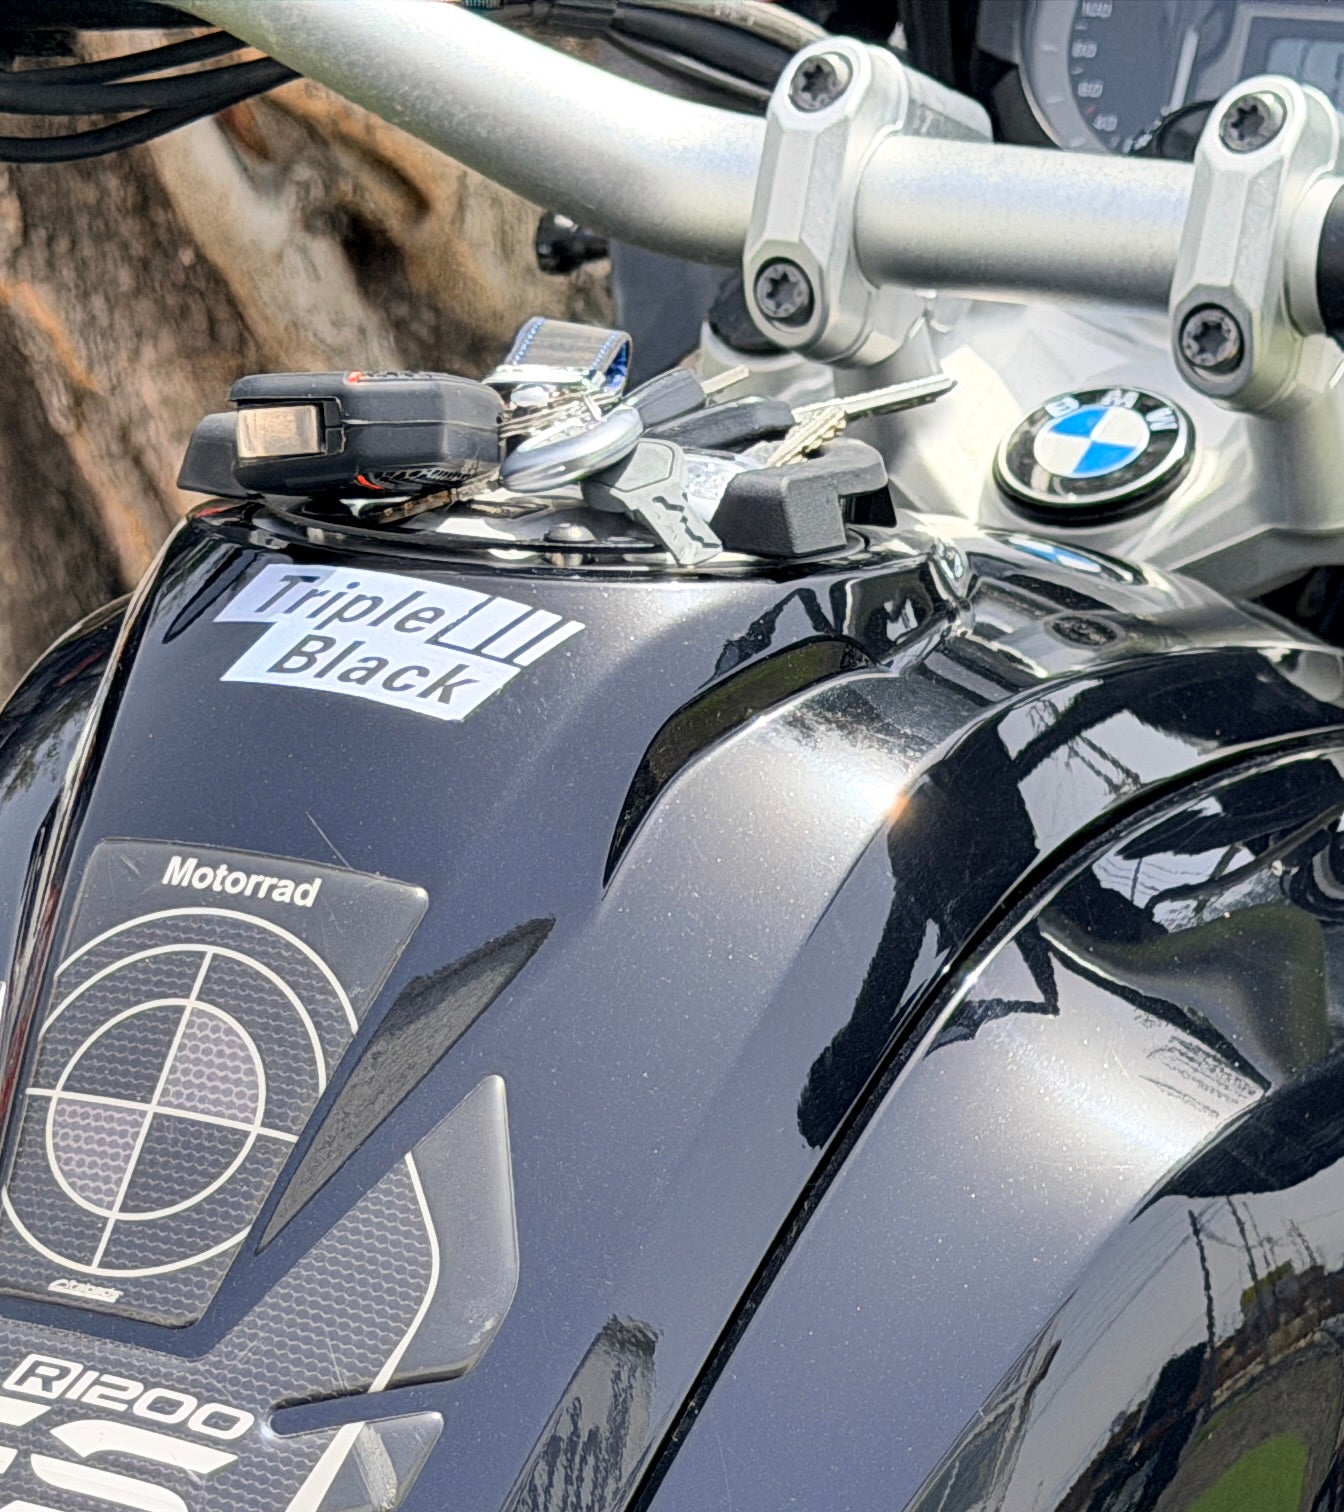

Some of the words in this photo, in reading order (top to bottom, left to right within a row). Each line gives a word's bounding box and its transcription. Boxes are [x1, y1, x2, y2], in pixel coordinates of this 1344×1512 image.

[1044, 388, 1179, 432] BMW
[254, 574, 447, 634] Triple
[266, 635, 480, 705] Black
[161, 855, 323, 908] Motorrad
[2, 1353, 256, 1441] R1200
